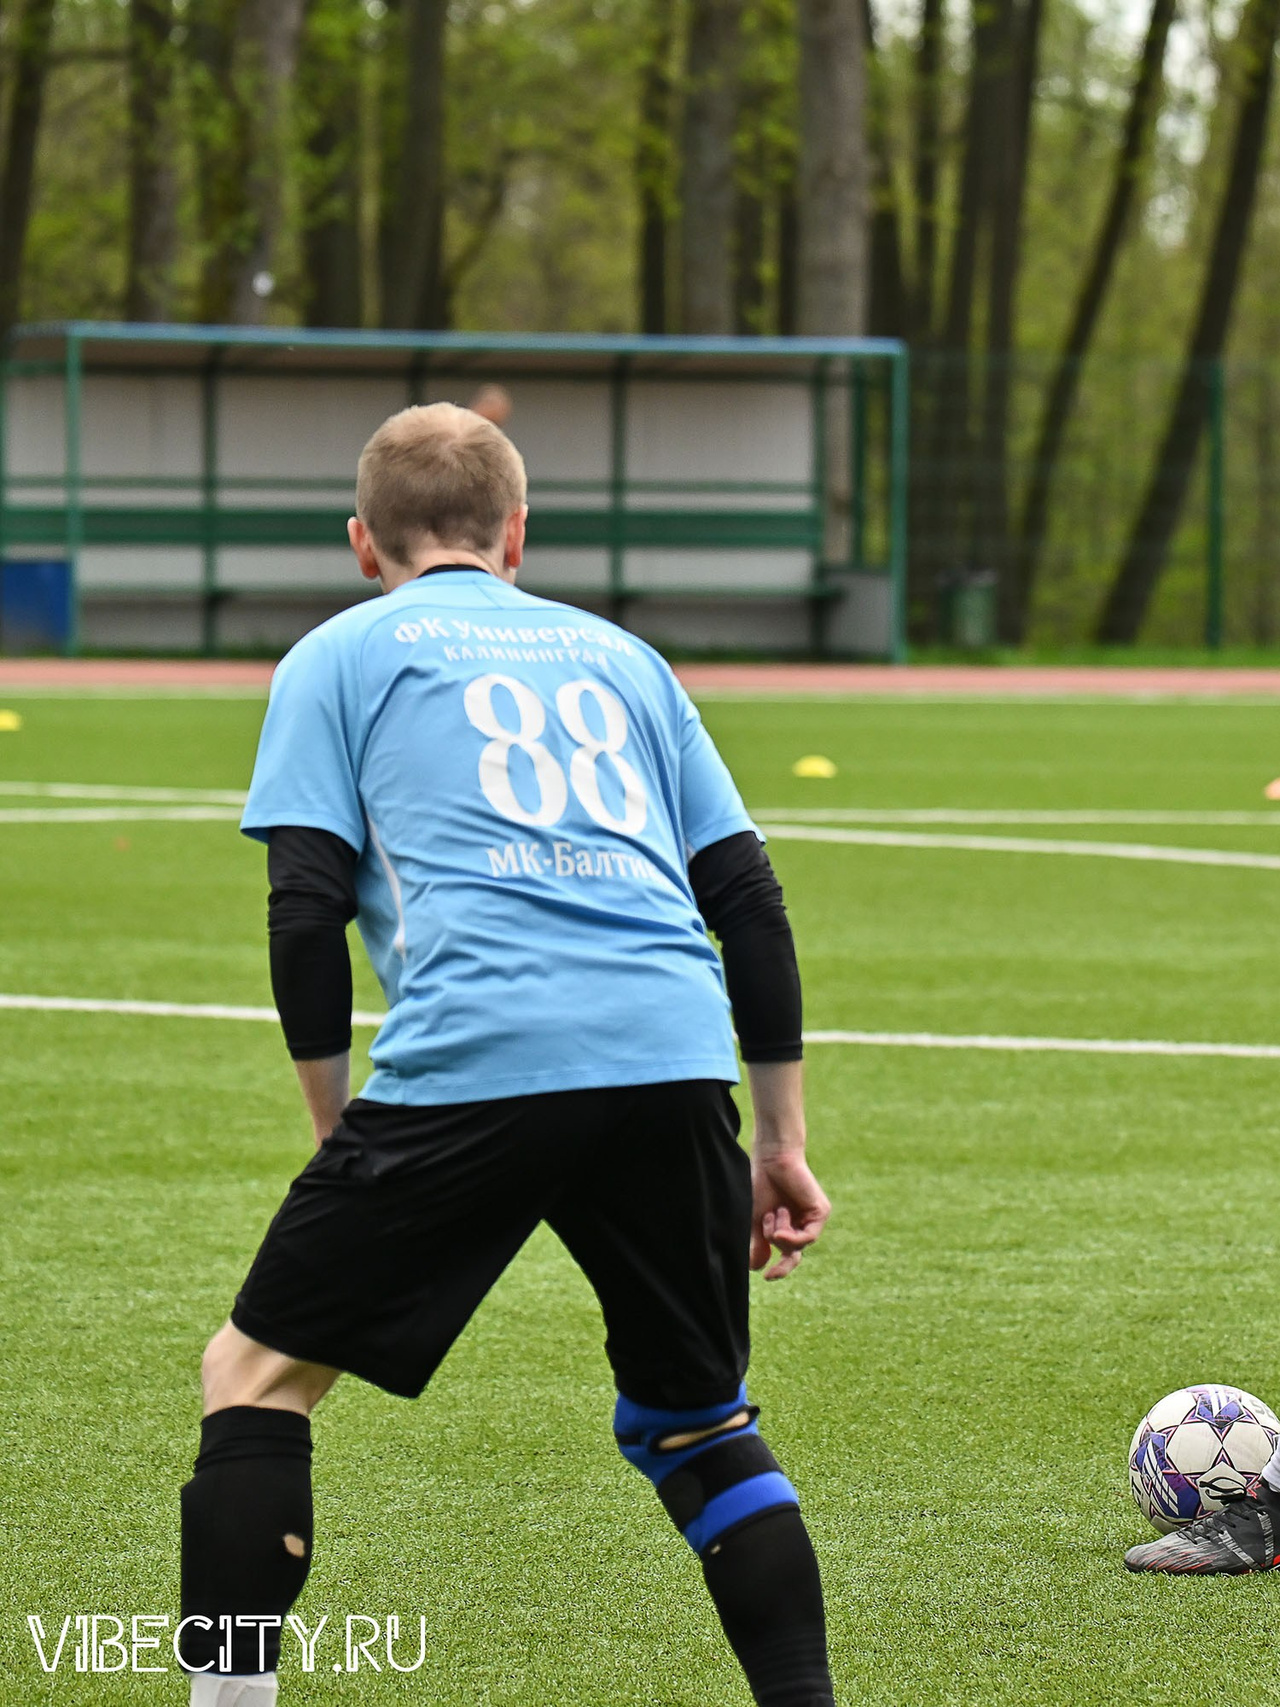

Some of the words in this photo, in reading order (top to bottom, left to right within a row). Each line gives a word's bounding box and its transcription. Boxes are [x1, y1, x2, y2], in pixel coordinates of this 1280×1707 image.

[394, 617, 447, 643] ФК
[444, 646, 608, 670] КАЛИНИНГРАД
[463, 672, 648, 837] 88
[486, 840, 661, 880] МК-Балти
